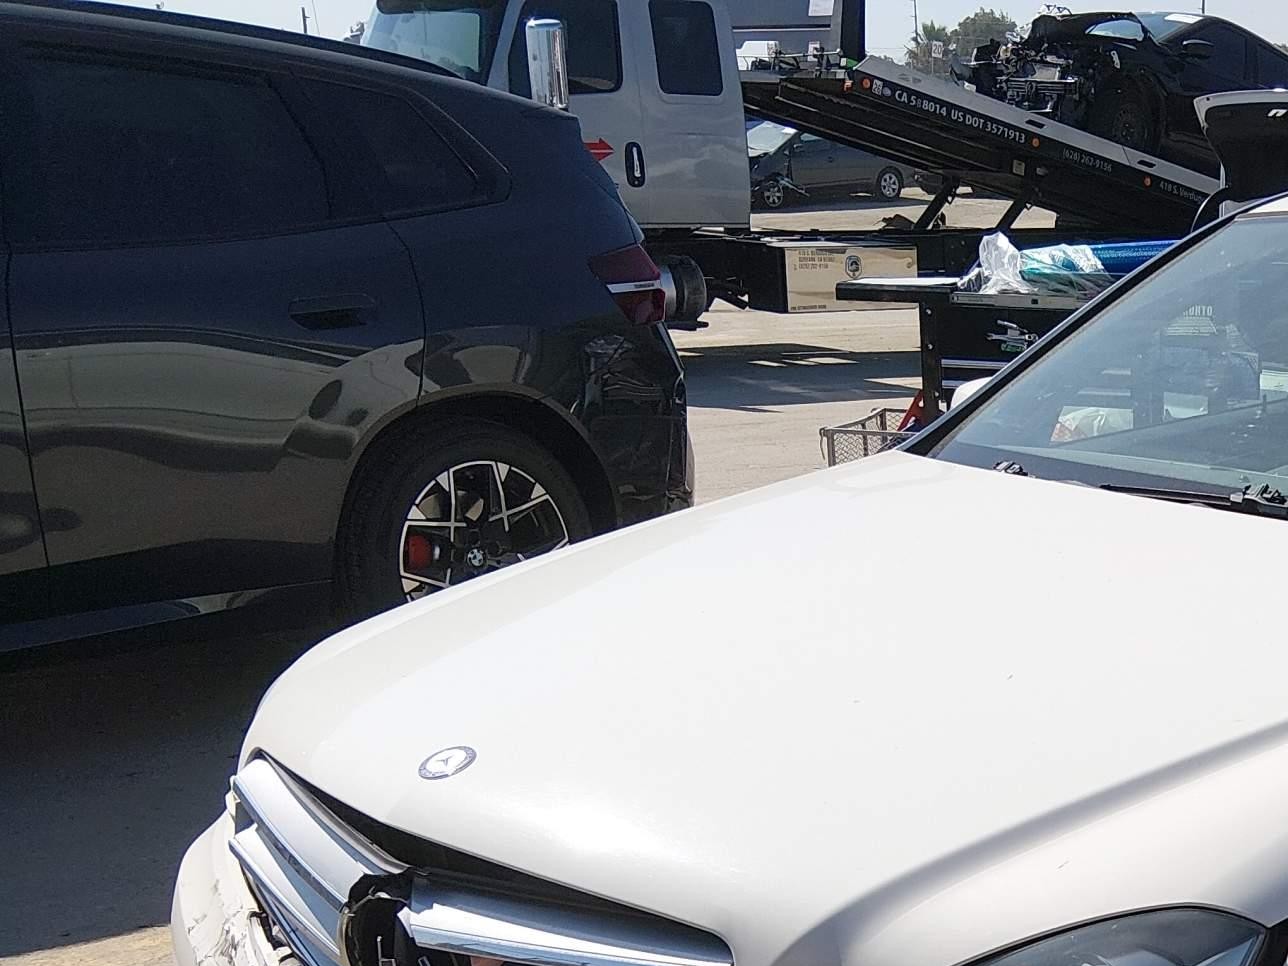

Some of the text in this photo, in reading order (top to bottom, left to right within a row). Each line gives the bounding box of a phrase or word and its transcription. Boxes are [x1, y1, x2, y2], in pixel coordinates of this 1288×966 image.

[894, 90, 908, 104] CA
[951, 108, 964, 122] US
[965, 113, 985, 129] DOT
[985, 121, 1025, 144] 3571913
